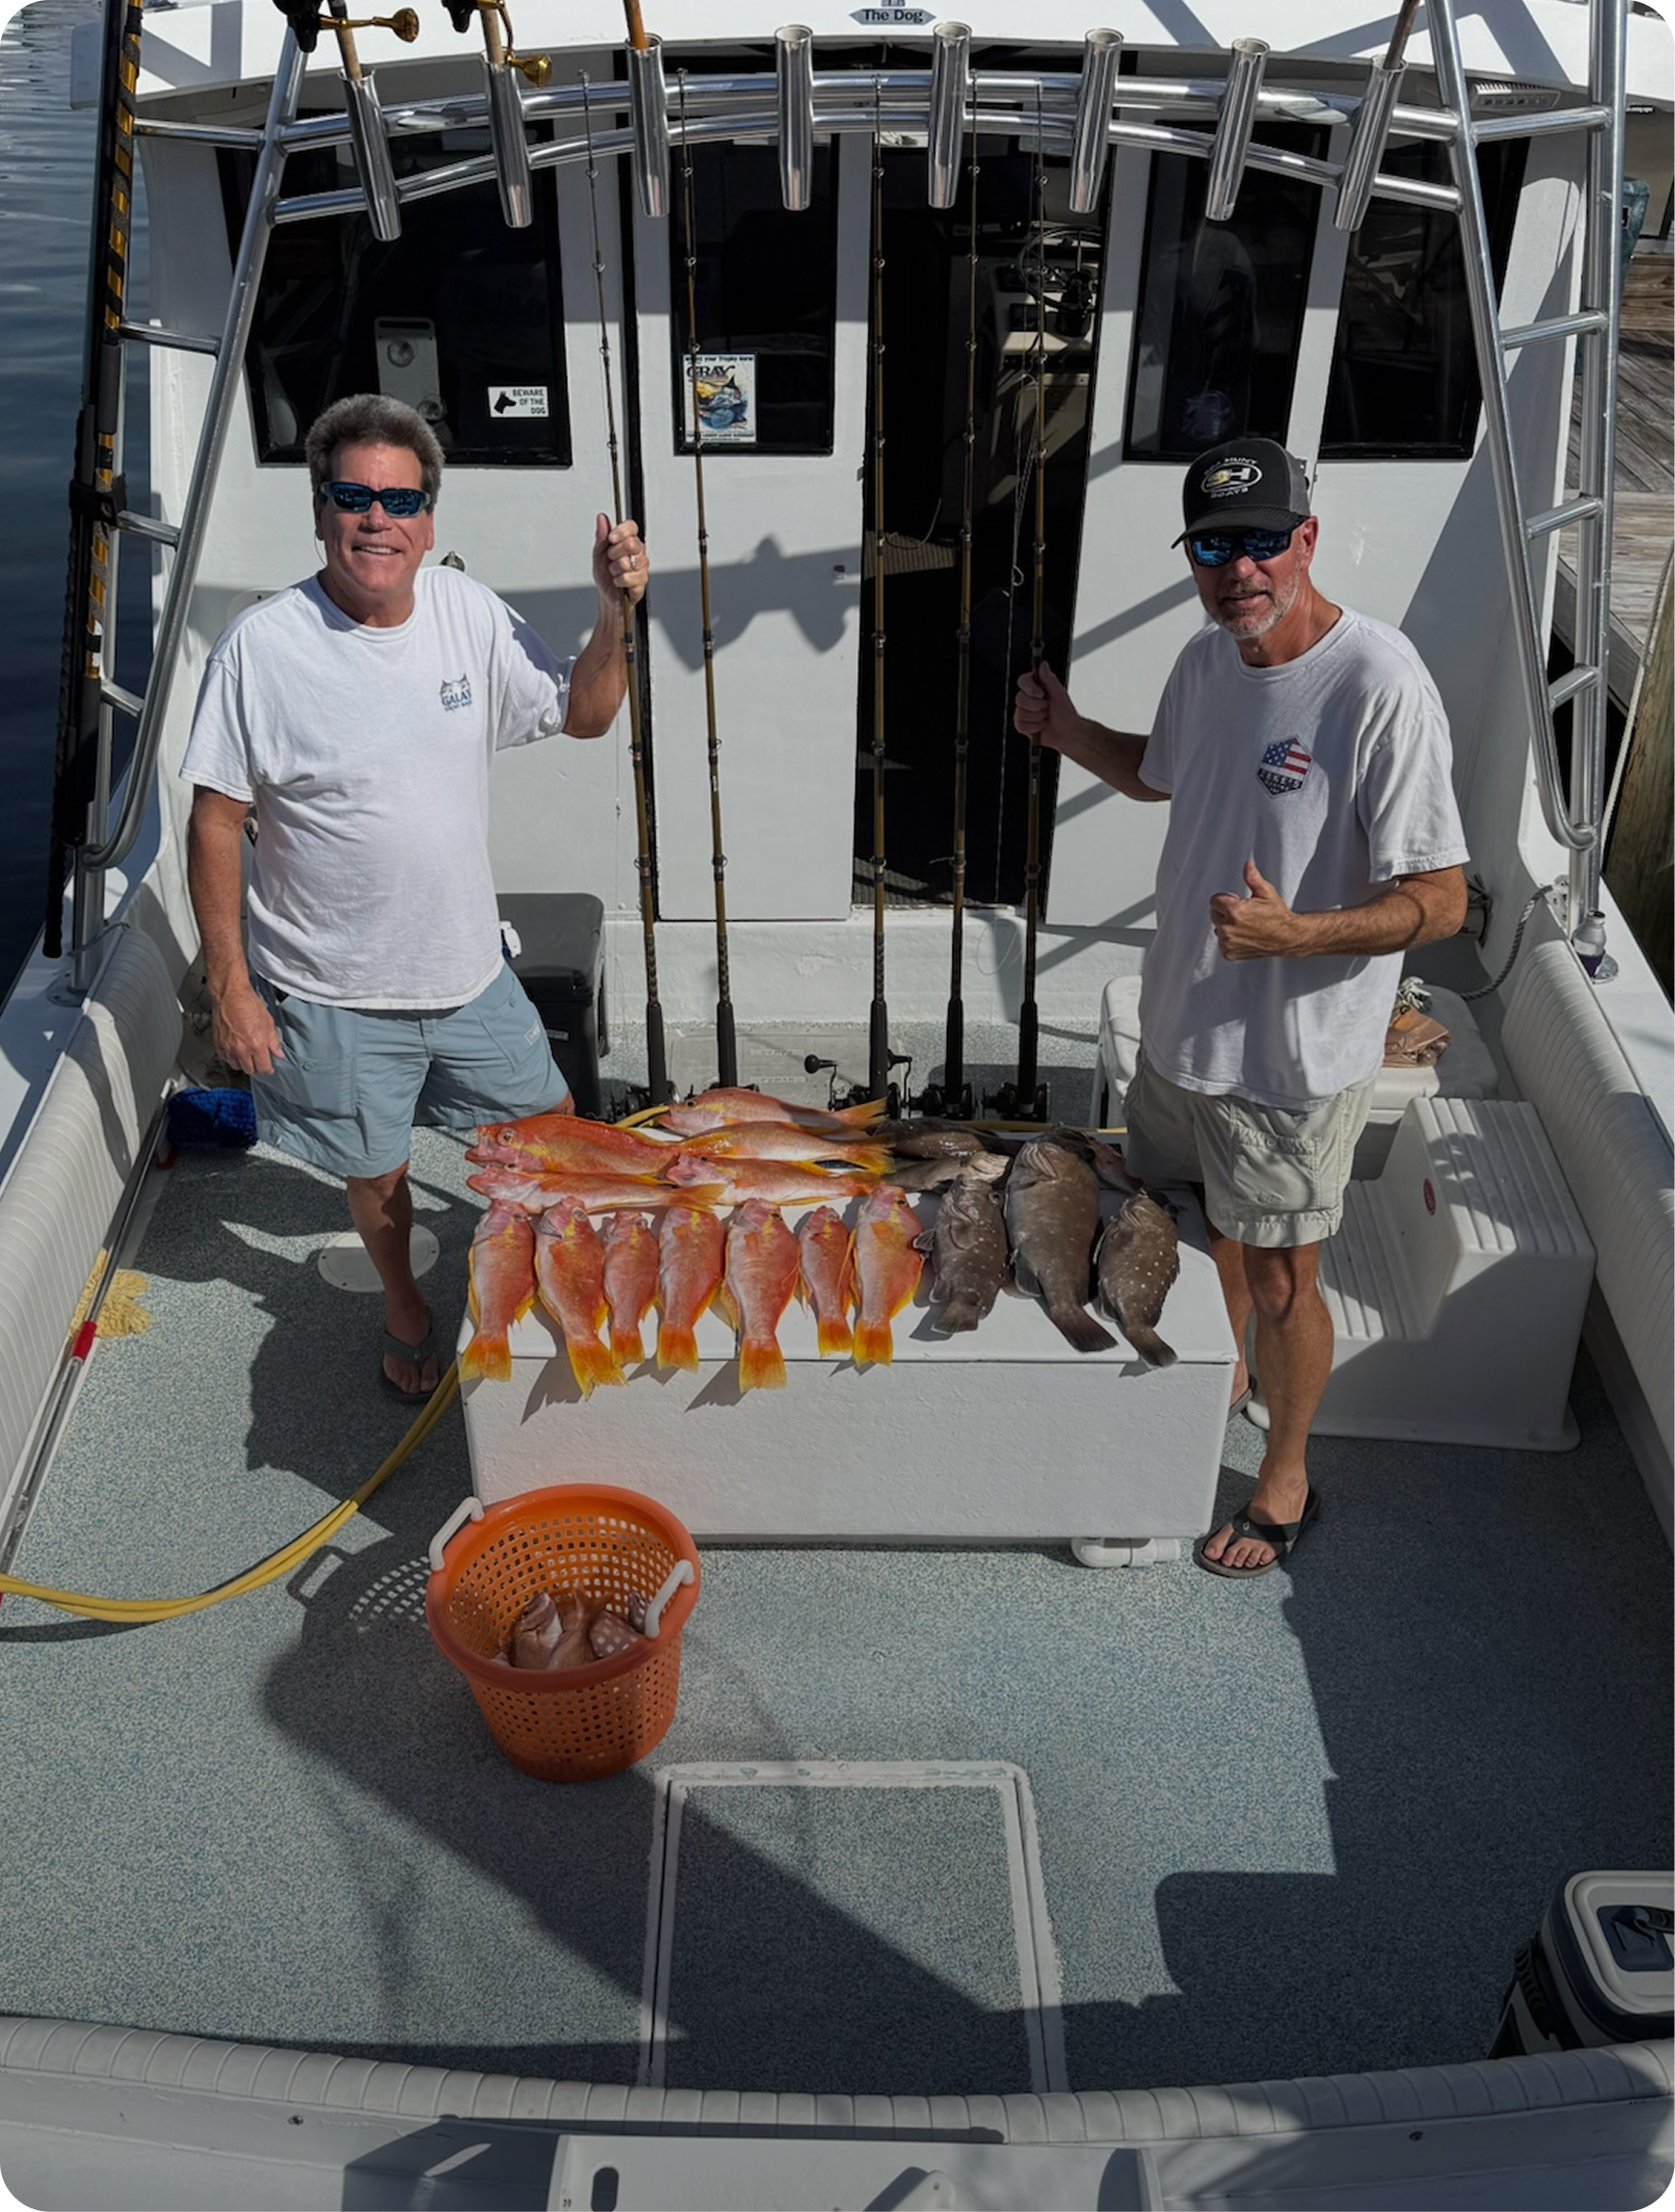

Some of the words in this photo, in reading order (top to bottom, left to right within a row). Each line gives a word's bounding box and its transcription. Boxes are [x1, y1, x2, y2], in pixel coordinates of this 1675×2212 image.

[863, 8, 889, 21] The
[893, 8, 923, 23] Dog
[687, 365, 736, 377] GRAY
